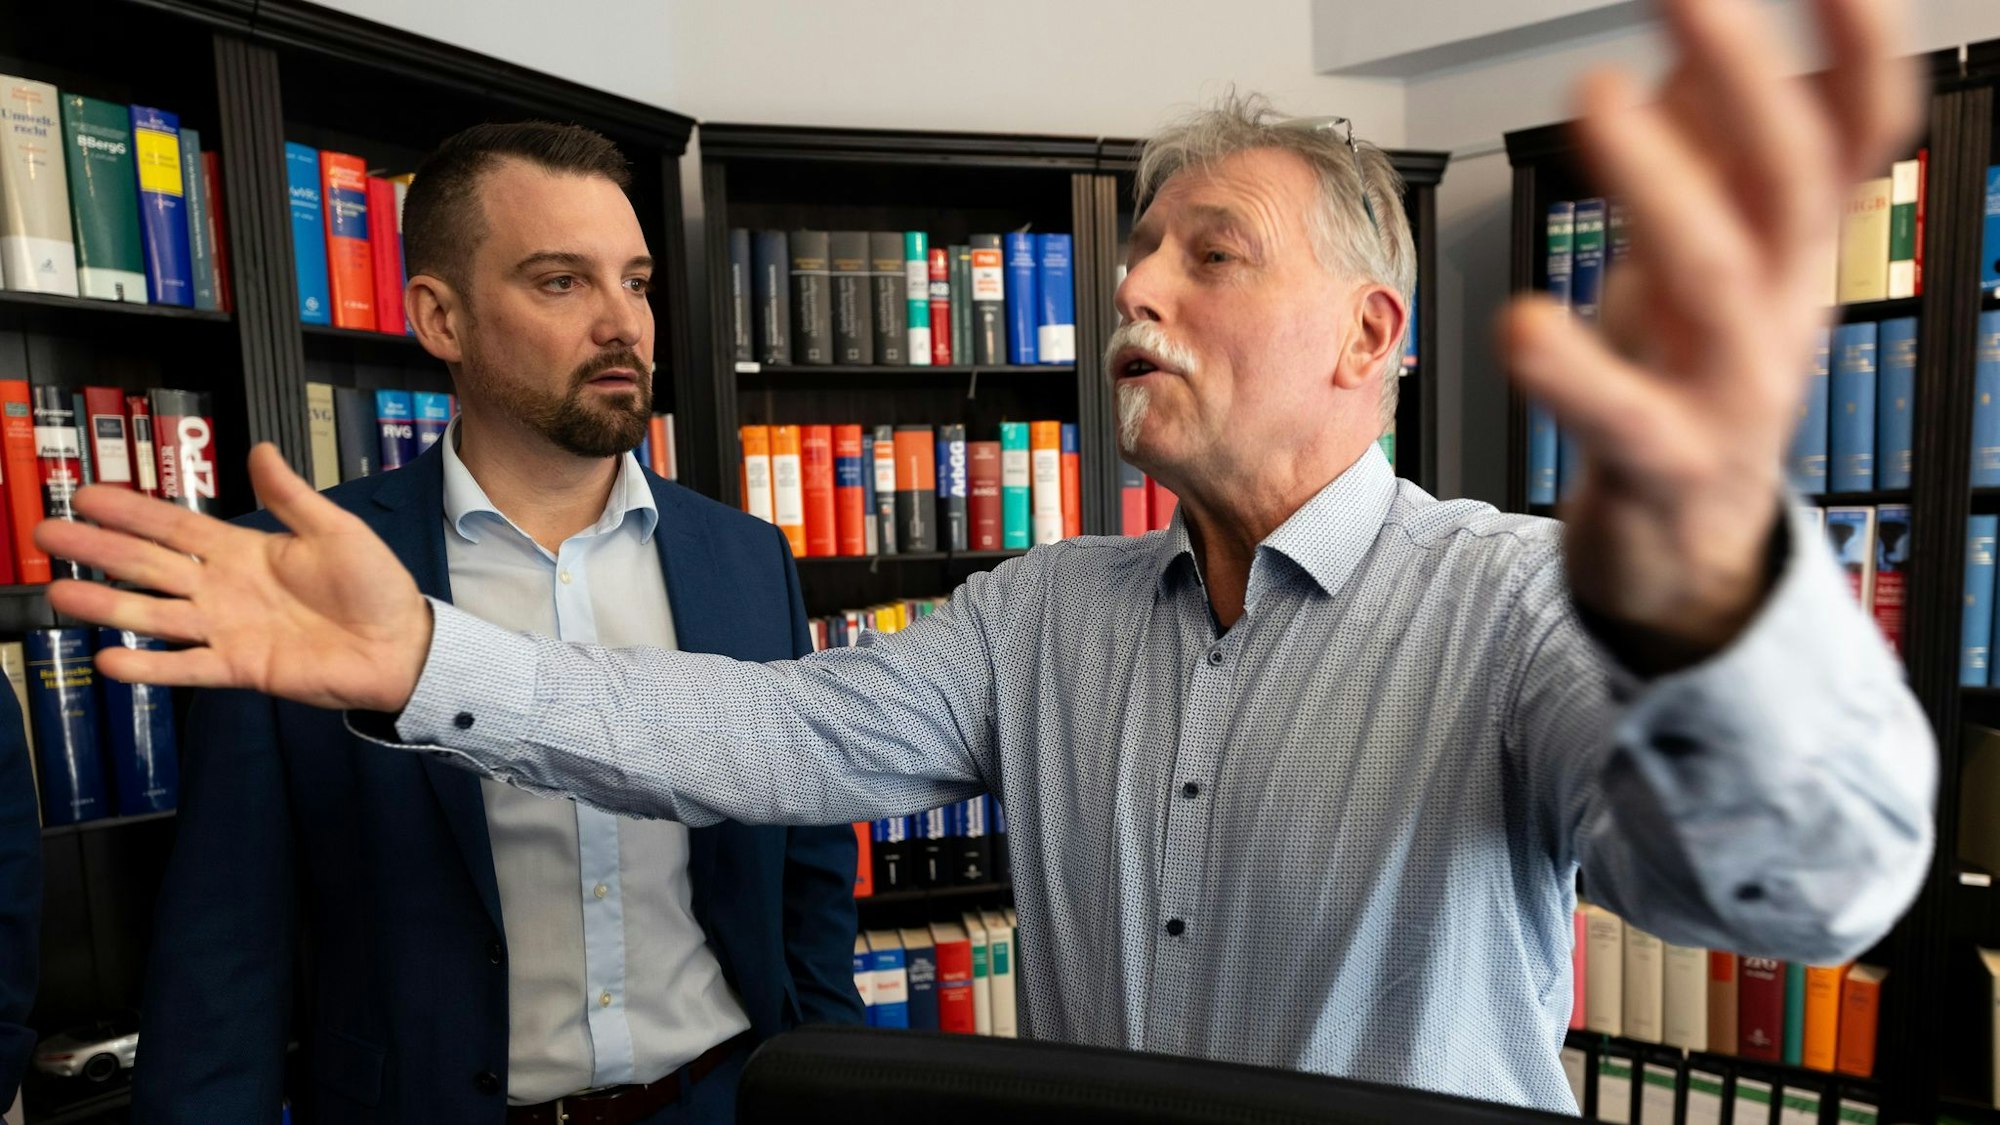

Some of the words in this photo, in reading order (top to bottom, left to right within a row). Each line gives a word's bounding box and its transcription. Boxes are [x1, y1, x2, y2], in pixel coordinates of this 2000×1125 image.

[14, 124, 48, 138] recht
[77, 134, 127, 155] BBergG
[383, 424, 413, 439] RVG
[177, 416, 215, 498] ZPO
[949, 441, 966, 498] ArbGG
